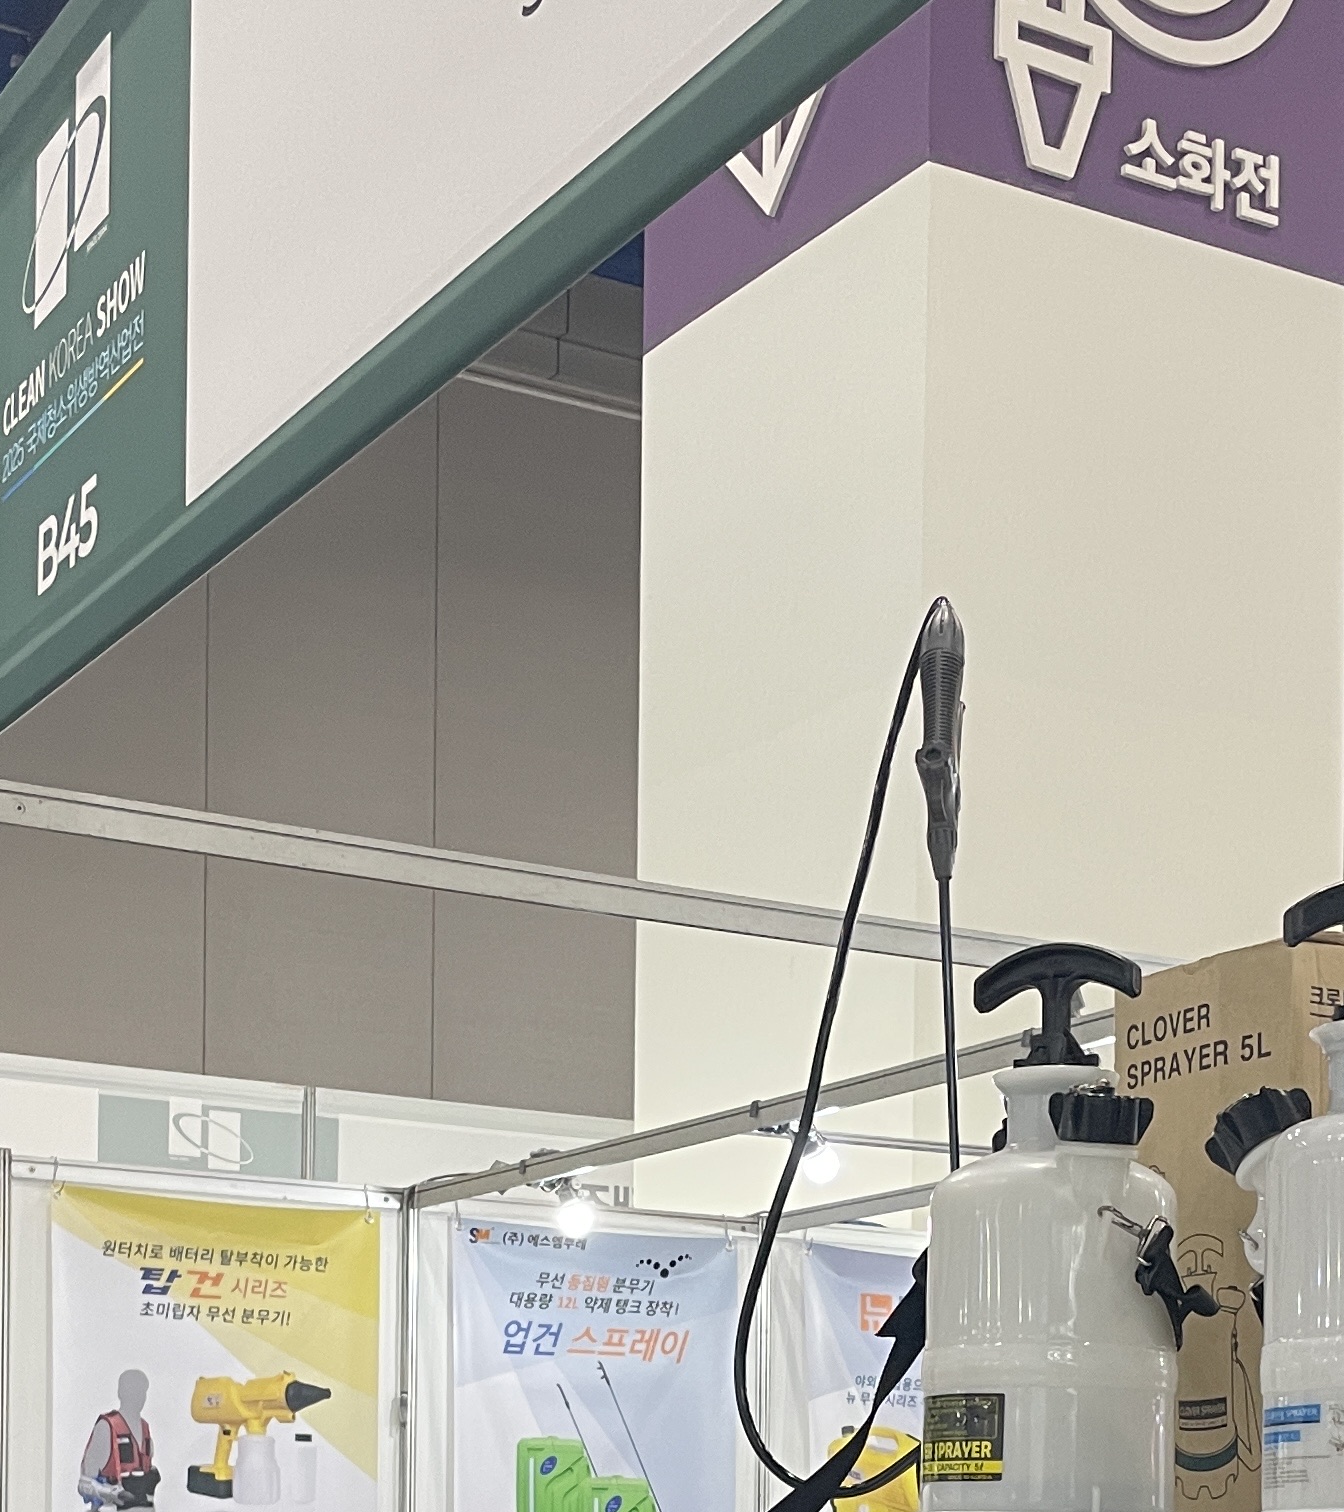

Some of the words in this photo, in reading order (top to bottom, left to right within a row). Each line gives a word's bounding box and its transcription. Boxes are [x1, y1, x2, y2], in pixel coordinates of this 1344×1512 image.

[1120, 118, 1280, 228] 소화전
[2, 360, 46, 437] CLEAN
[48, 311, 94, 388] KOREA
[96, 250, 146, 338] SHOW
[1, 437, 26, 484] 2025
[37, 474, 98, 596] B45
[1126, 1003, 1212, 1050] CLOVER
[1126, 1039, 1229, 1090] SPRAYER
[1240, 1030, 1272, 1063] 5L
[102, 1239, 163, 1260] 원터치로
[169, 1246, 215, 1263] 배터리
[220, 1249, 279, 1269] 탈부착이
[284, 1254, 329, 1273] 가능한
[502, 1231, 524, 1247] (주)
[139, 1266, 225, 1300] 탑건
[230, 1277, 289, 1299] 시리즈
[536, 1272, 565, 1290] 무선
[612, 1277, 655, 1296] 분무기
[139, 1301, 201, 1321] 초미립자
[206, 1305, 237, 1324] 무선
[241, 1307, 291, 1327] 분무기!
[509, 1292, 553, 1310] 대용량
[584, 1297, 612, 1314] 약제
[615, 1299, 642, 1315] 탱크
[646, 1300, 680, 1318] 장착!
[503, 1320, 563, 1356] 업건
[566, 1326, 690, 1364] 스프레이
[885, 1394, 918, 1407] 시리즈
